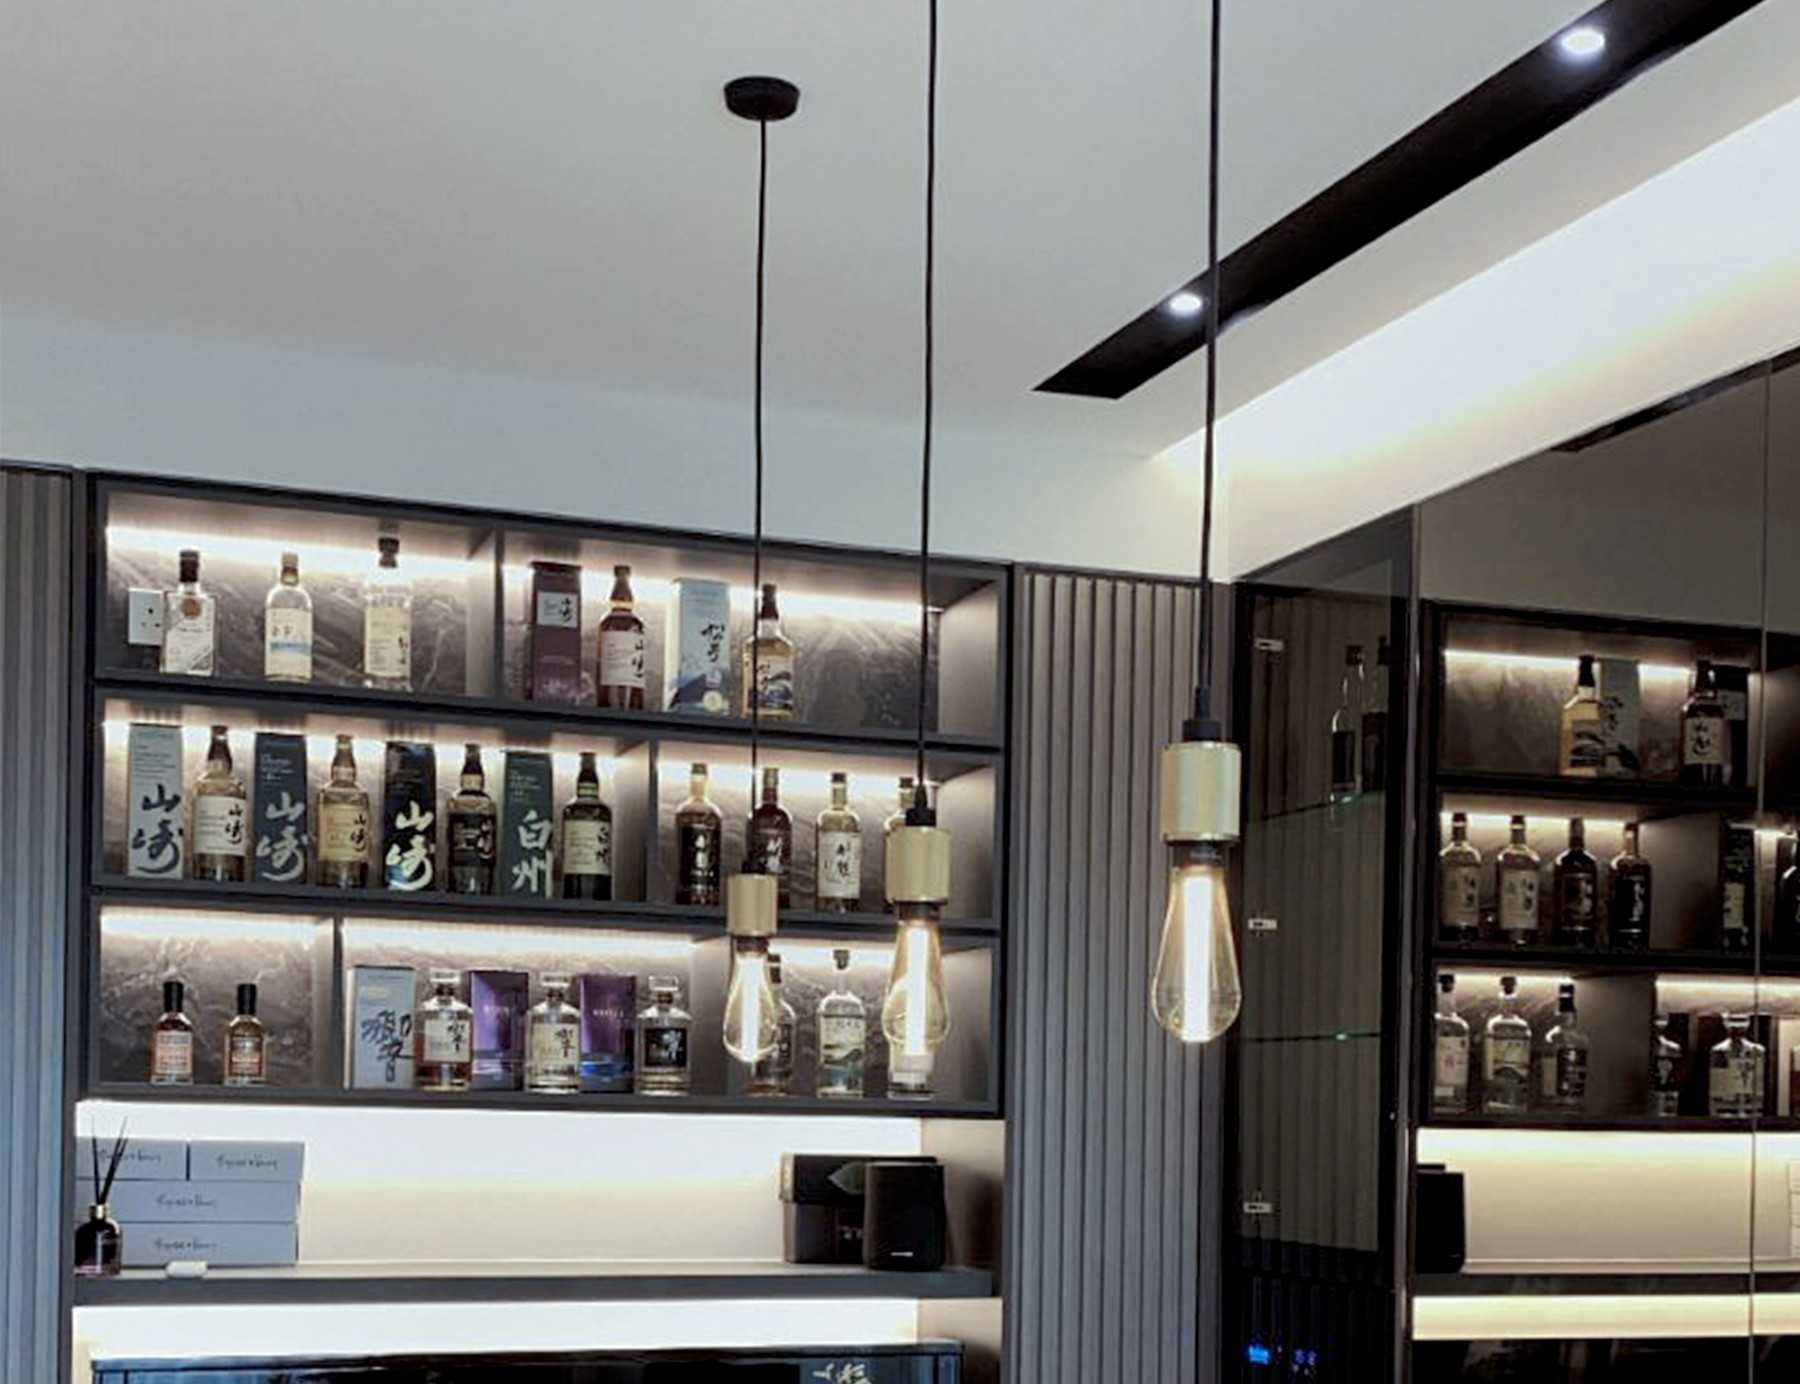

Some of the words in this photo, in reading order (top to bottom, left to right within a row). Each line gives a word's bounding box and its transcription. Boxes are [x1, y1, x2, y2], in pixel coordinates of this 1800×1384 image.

[131, 783, 184, 874] 山崎
[256, 791, 309, 882] 山崎
[386, 799, 436, 891] 山崎
[511, 809, 553, 900] 白州
